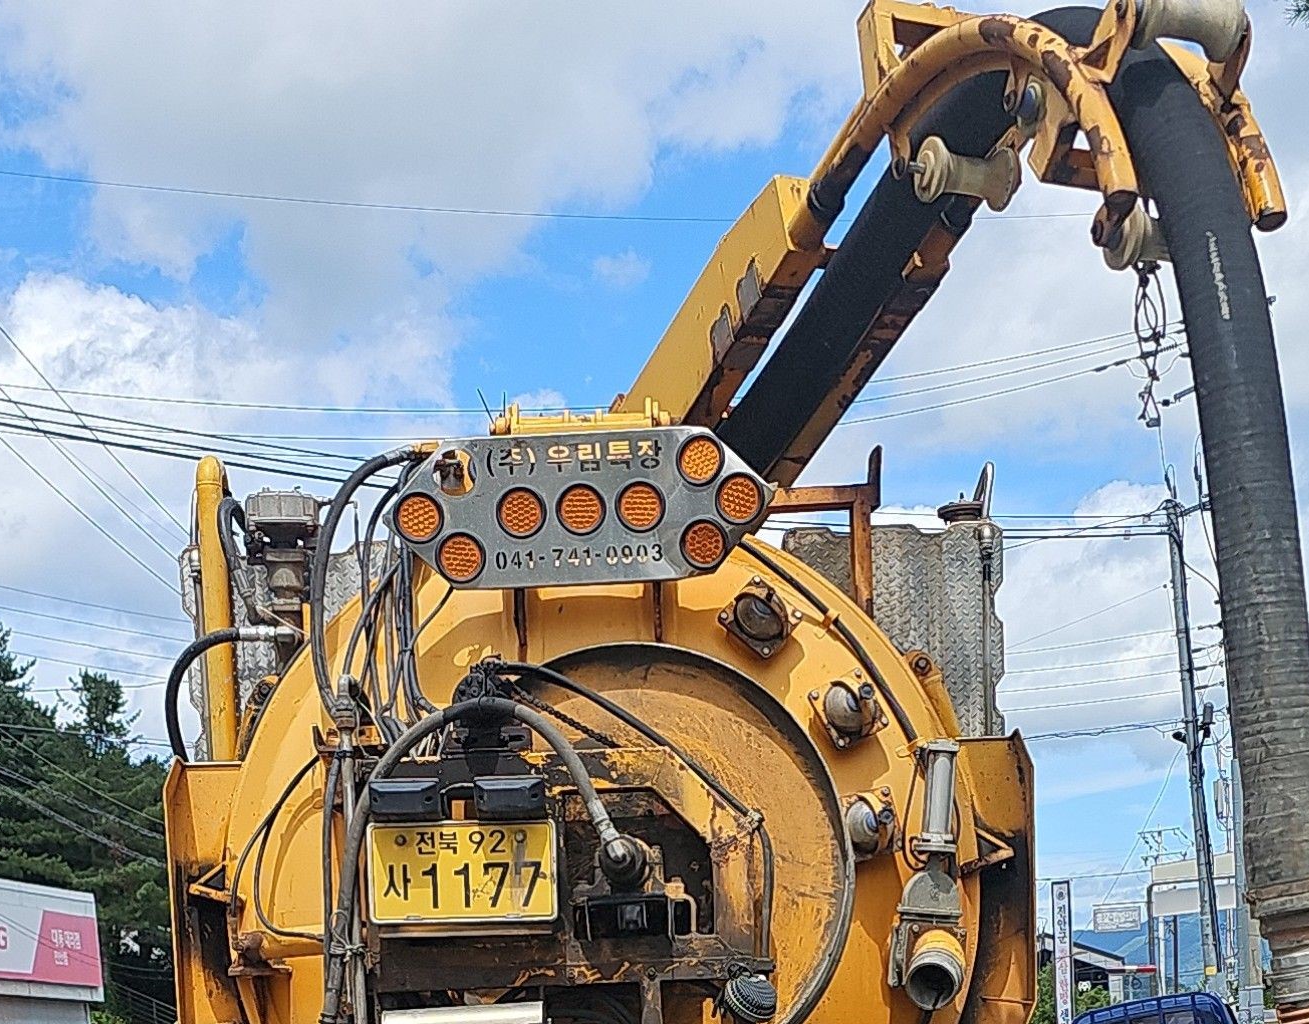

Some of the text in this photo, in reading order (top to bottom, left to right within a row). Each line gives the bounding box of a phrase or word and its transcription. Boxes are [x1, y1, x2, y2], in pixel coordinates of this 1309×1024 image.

[487, 440, 663, 477] (주) 우림특장
[495, 543, 664, 570] 041-741-0903
[415, 829, 507, 855] 전북 92
